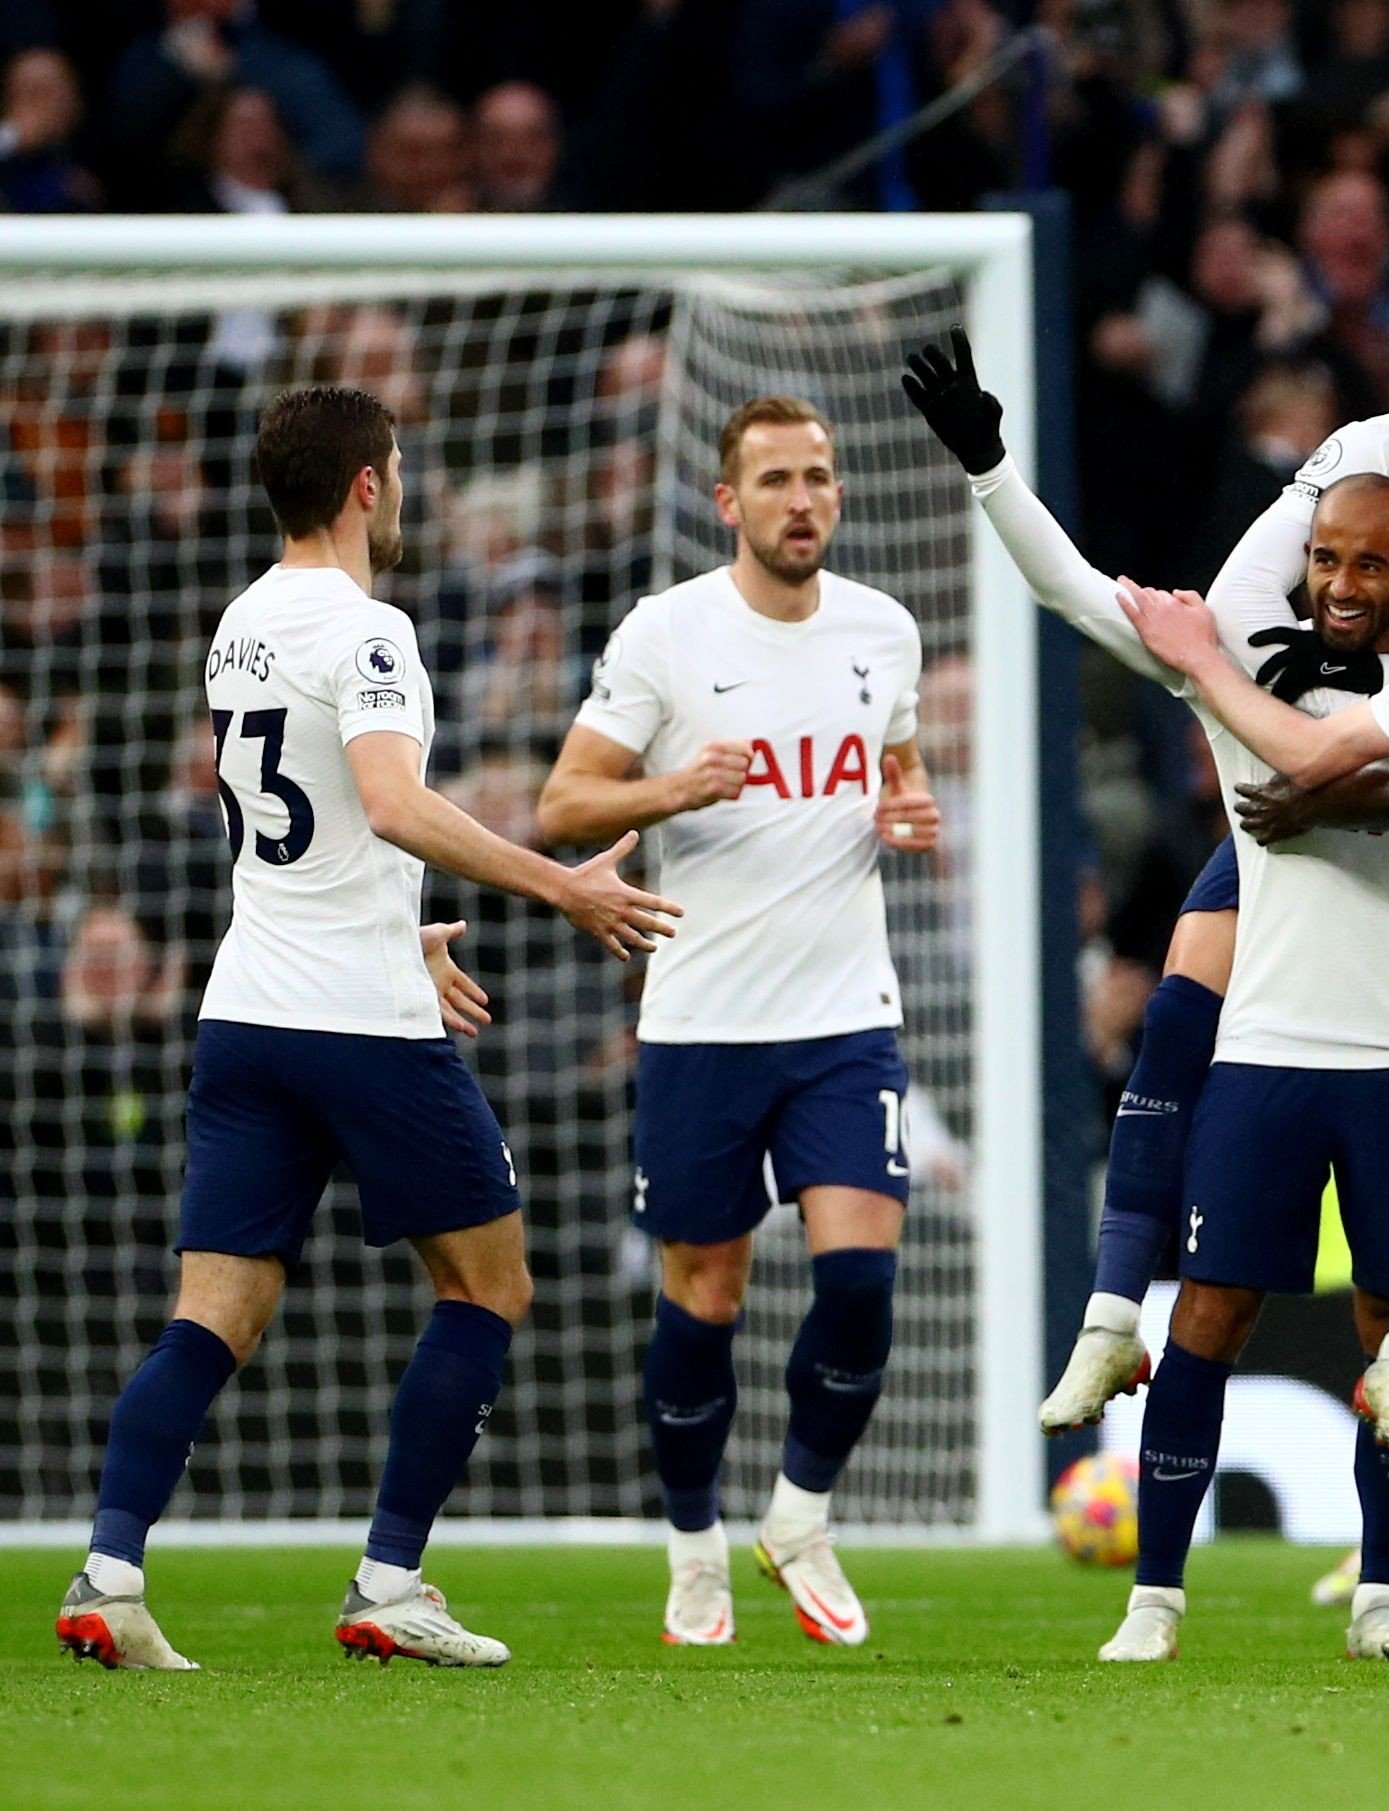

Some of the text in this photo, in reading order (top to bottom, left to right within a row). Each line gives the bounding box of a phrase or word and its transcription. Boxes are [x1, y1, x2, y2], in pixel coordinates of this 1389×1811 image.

[208, 637, 276, 683] DAVIES
[730, 733, 868, 801] AIA
[1119, 1090, 1180, 1113] SPURS
[1144, 1449, 1209, 1470] SPURS
